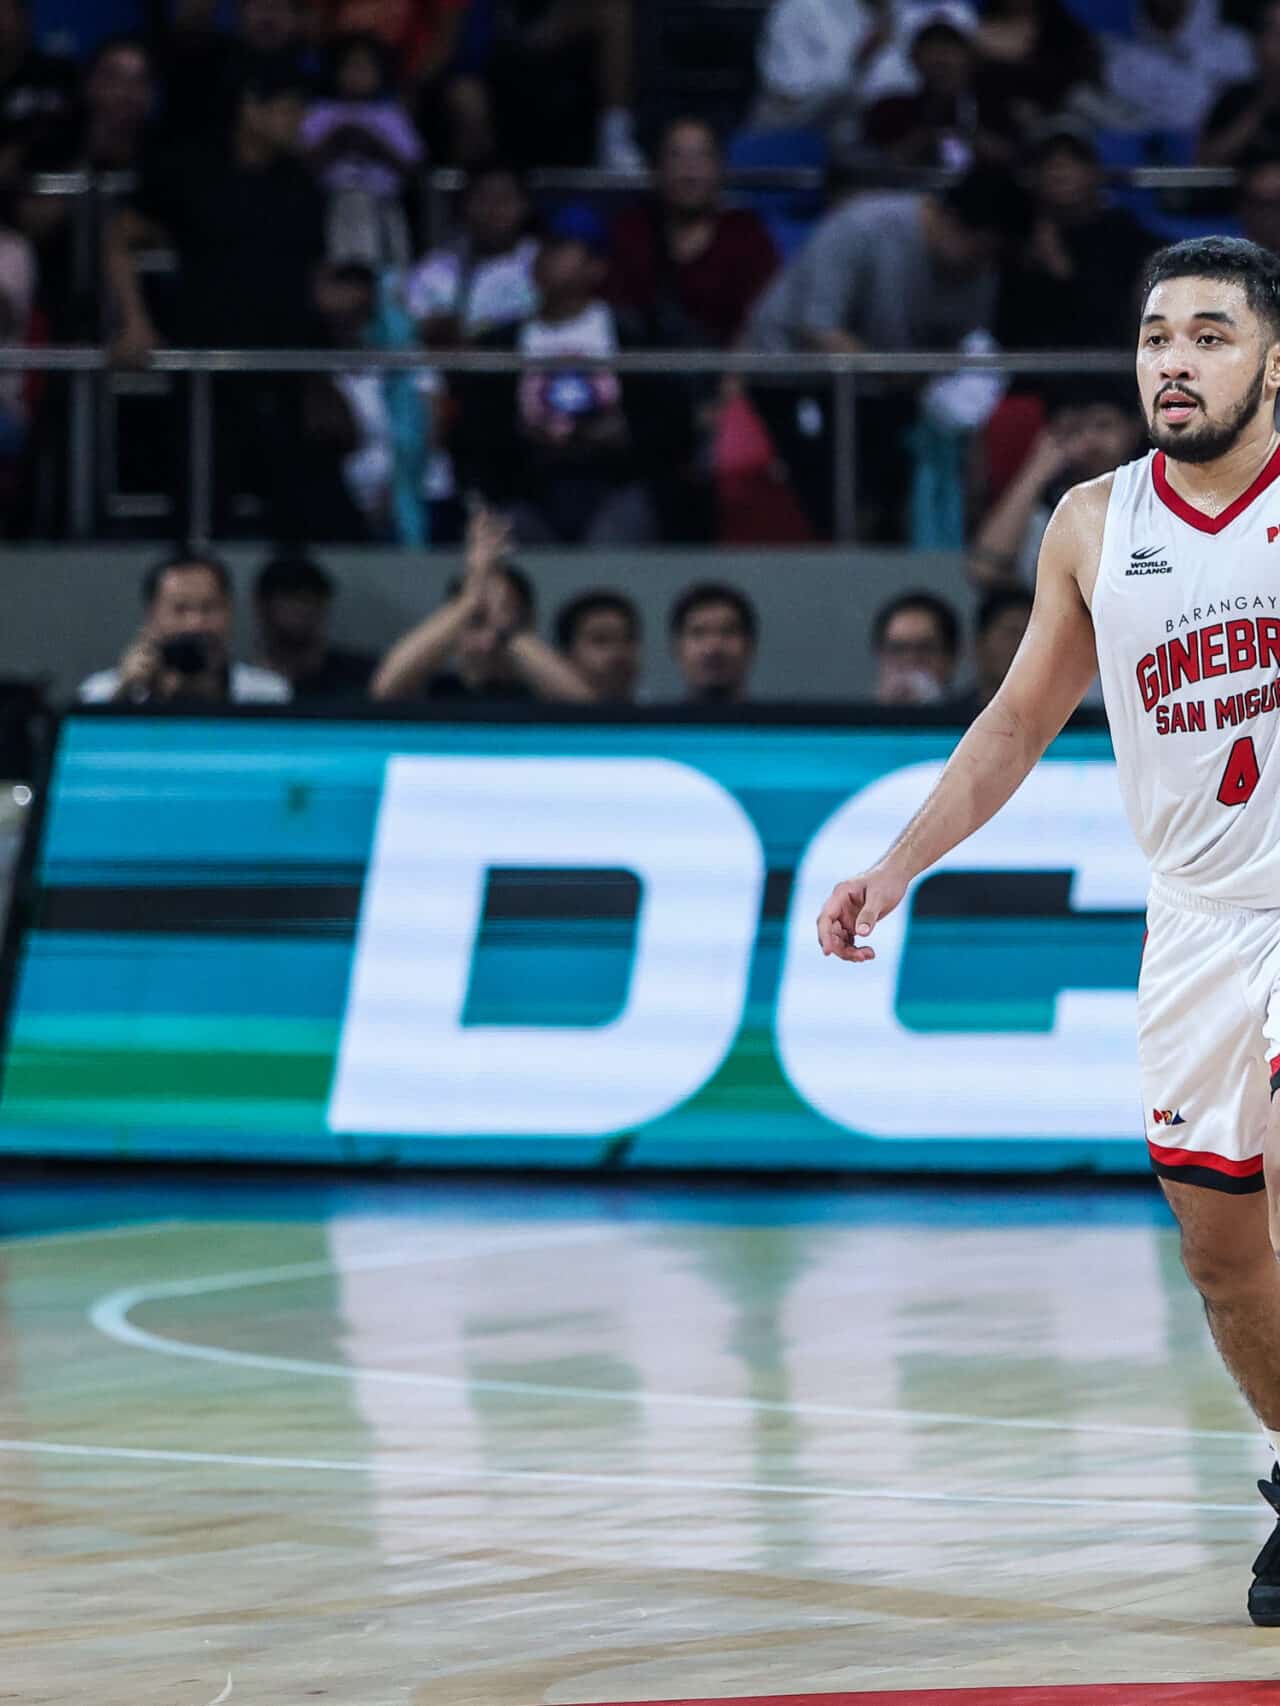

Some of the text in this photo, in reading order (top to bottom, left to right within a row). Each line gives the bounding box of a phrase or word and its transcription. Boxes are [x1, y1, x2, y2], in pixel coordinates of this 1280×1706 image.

[1125, 567, 1173, 576] BALANCE
[1130, 560, 1168, 569] WORLD
[1165, 596, 1277, 633] BARANGAY
[1156, 700, 1207, 735] SAN
[1216, 736, 1260, 807] 4
